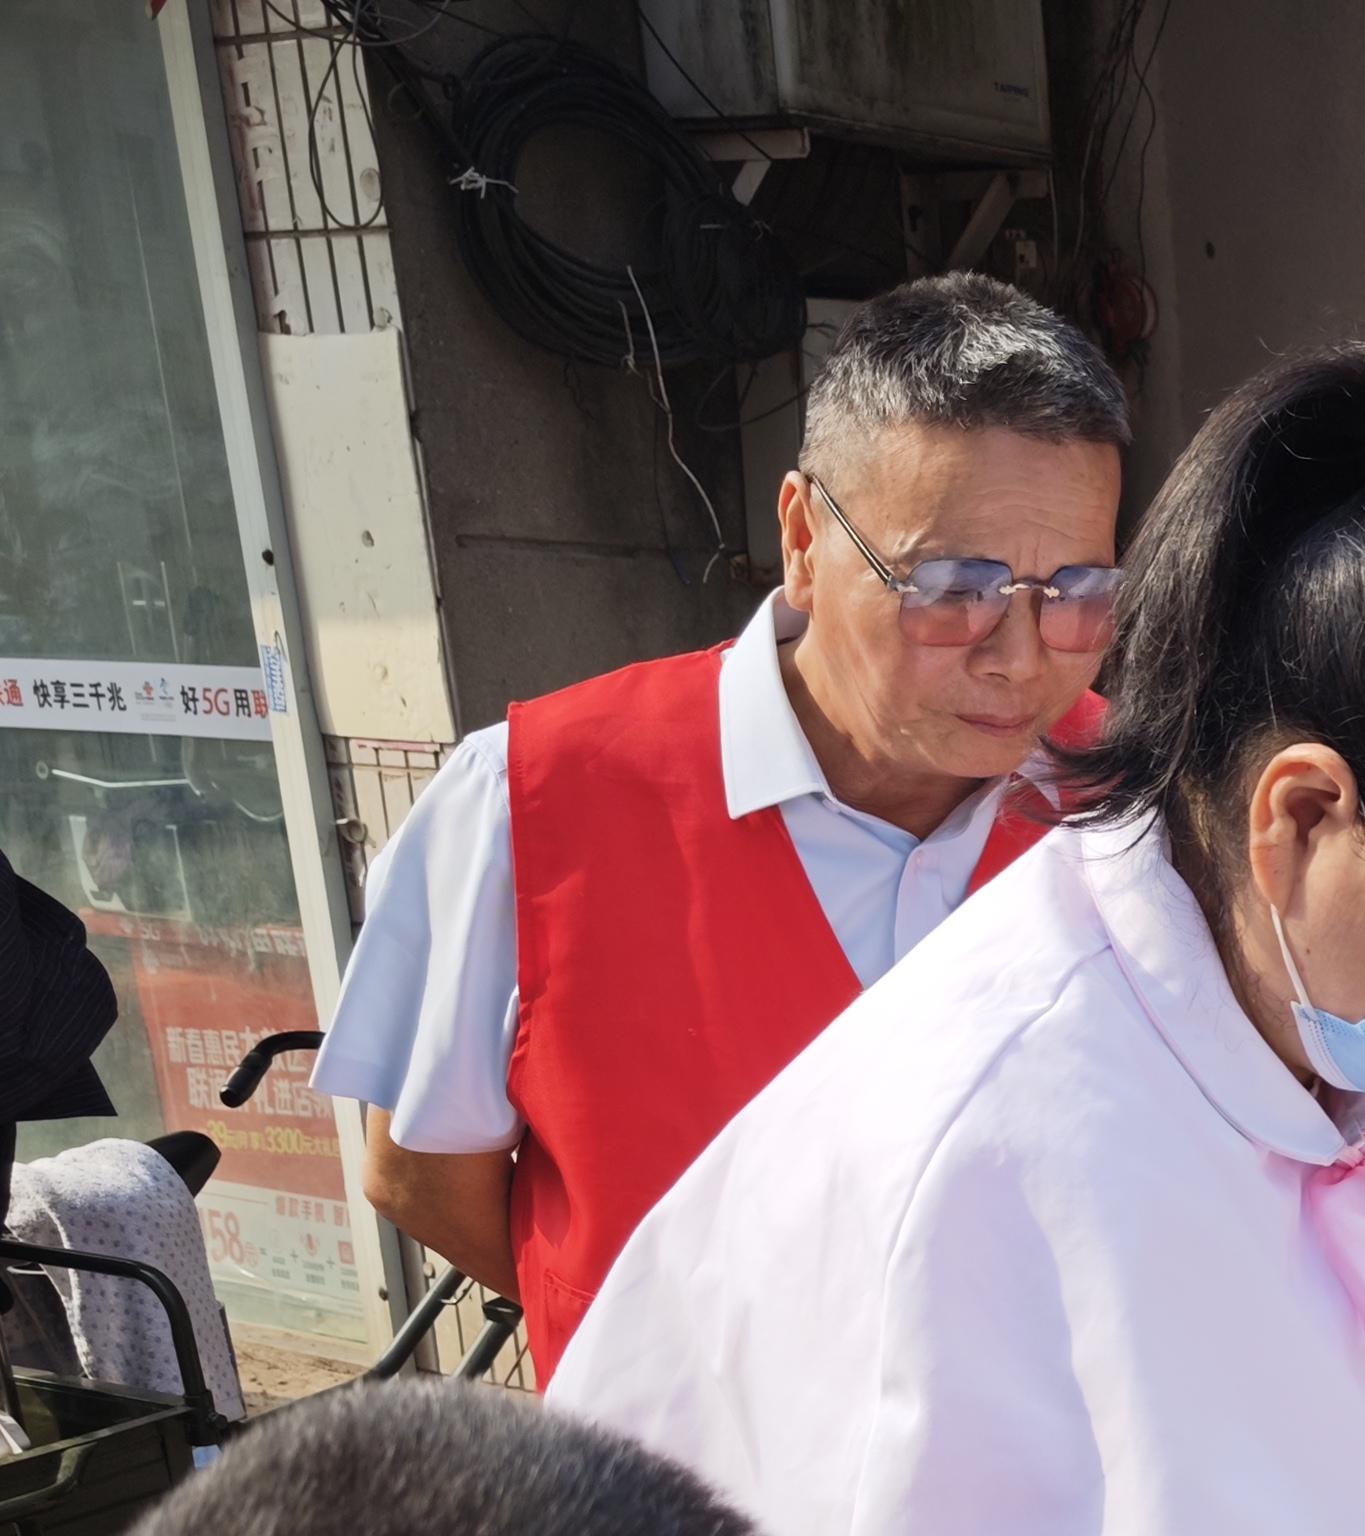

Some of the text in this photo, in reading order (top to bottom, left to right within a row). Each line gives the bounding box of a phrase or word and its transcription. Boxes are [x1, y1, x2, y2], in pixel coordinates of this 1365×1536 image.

[0, 678, 25, 708] 通
[32, 680, 128, 712] 快享三千兆
